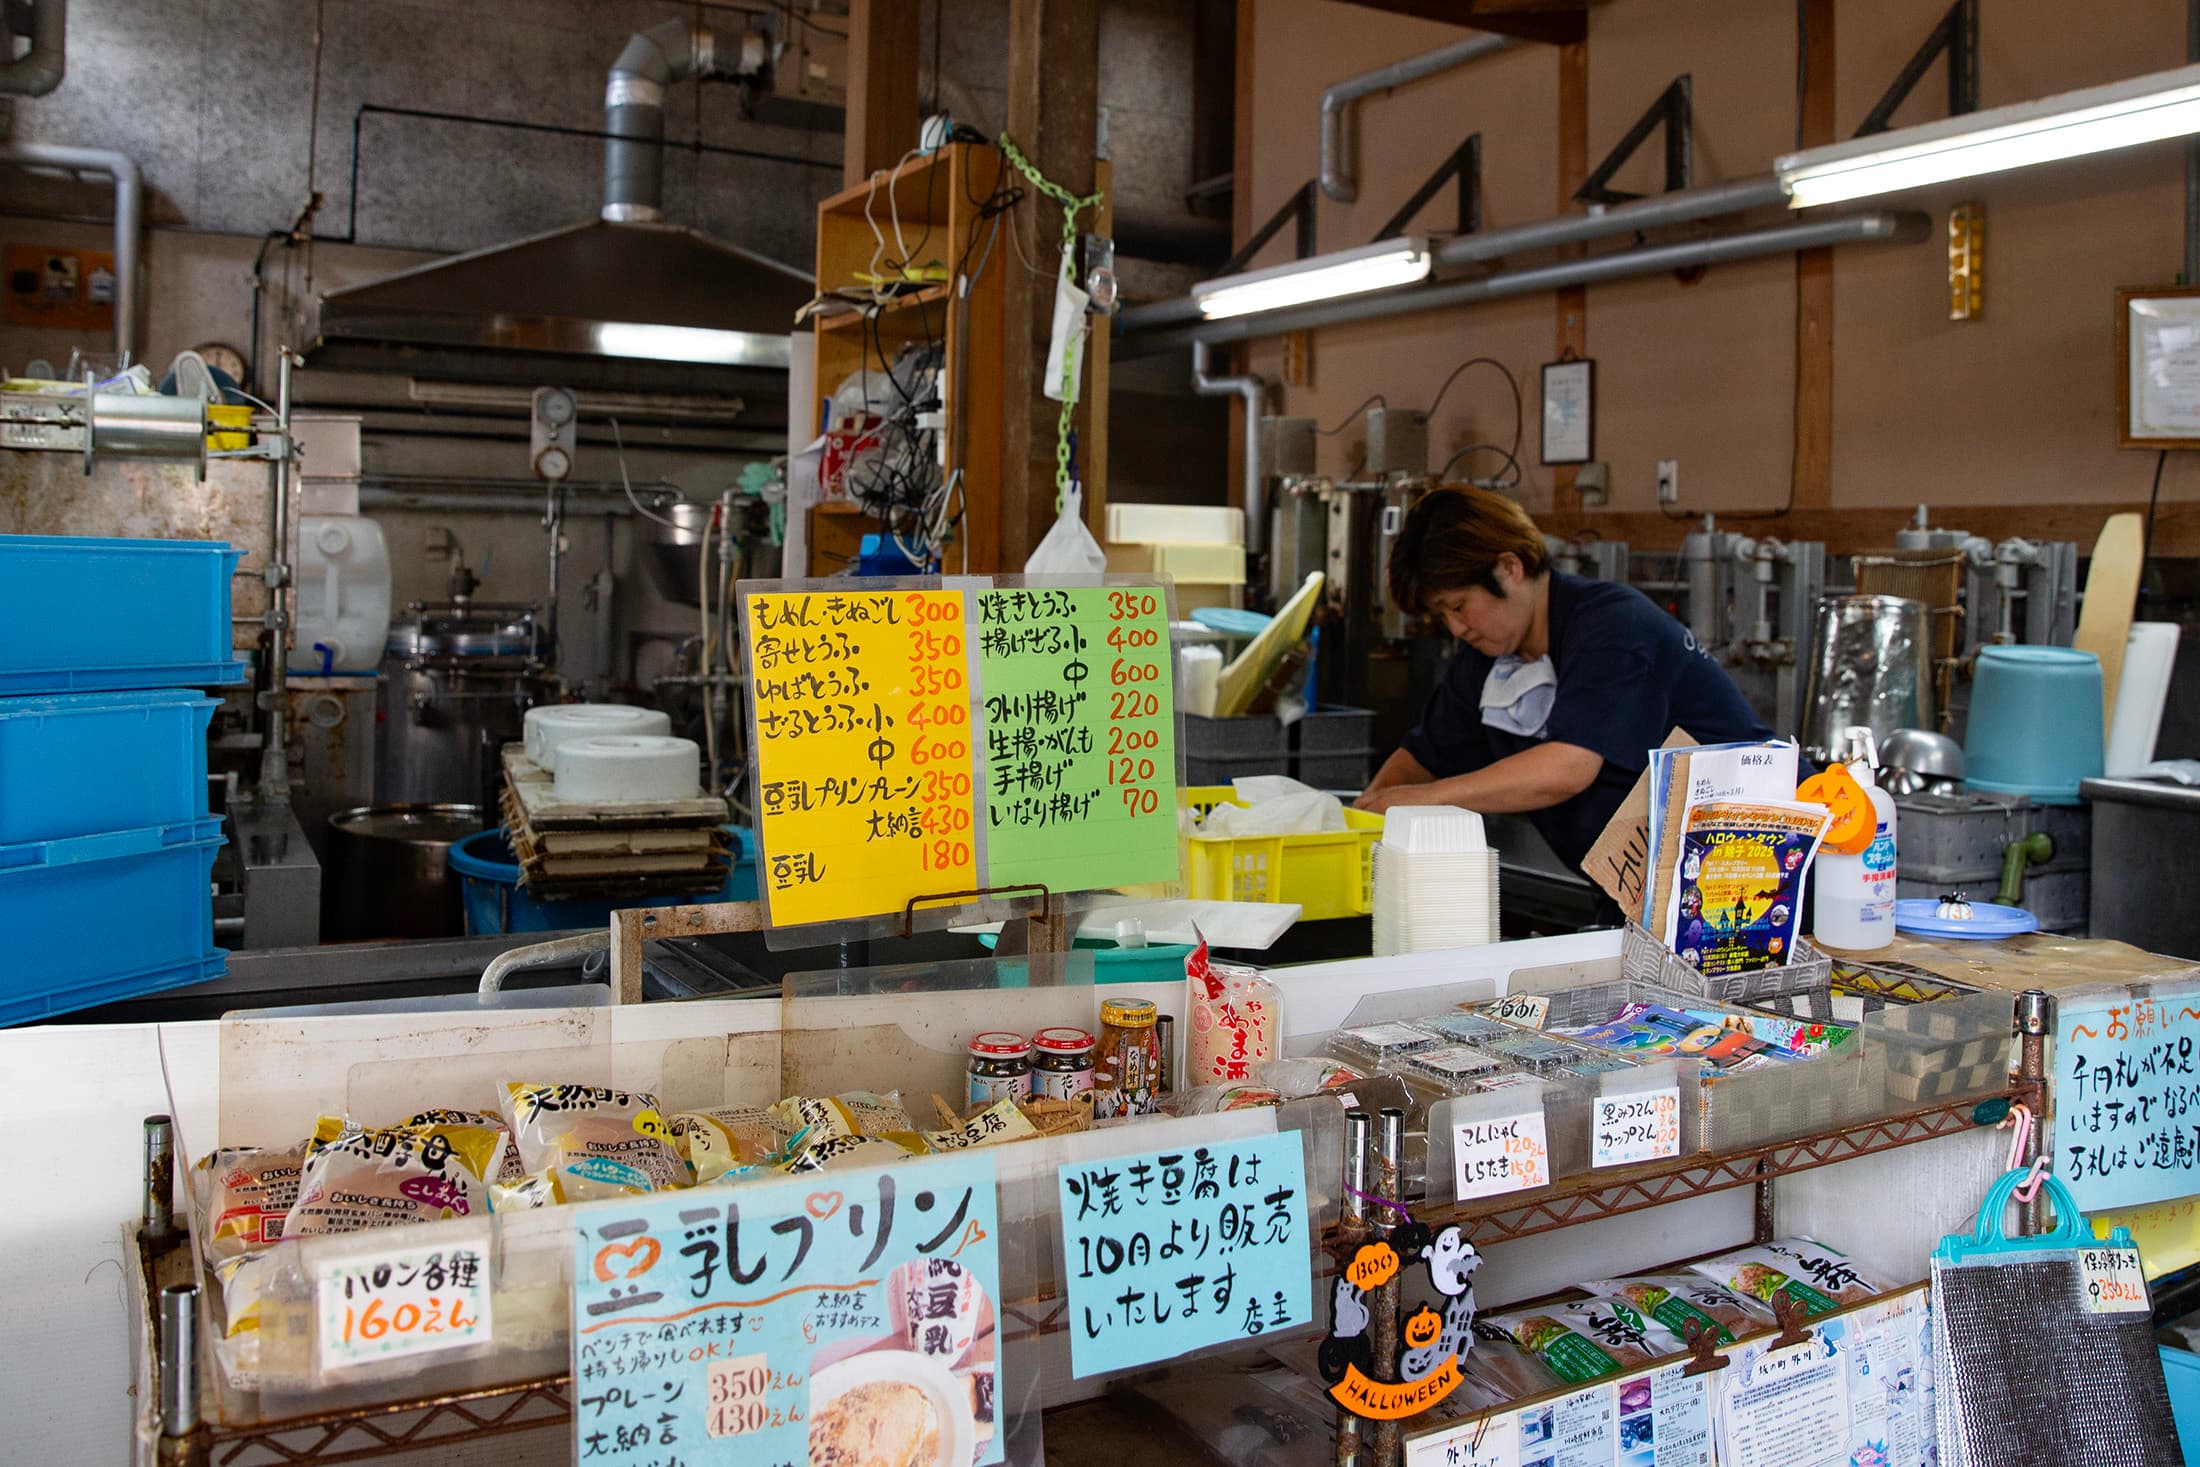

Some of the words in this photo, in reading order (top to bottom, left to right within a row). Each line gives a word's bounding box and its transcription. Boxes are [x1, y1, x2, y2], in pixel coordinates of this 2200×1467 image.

[905, 594, 959, 627] 300
[978, 591, 1077, 624] 焼きとうふ
[1108, 591, 1157, 621] 350
[756, 632, 860, 669] 寄せとうふ
[908, 629, 961, 662] 350
[1107, 626, 1158, 653] 400
[756, 666, 870, 703] ゆばとうふ
[909, 664, 962, 697] 350
[1063, 657, 1089, 690] 中
[1111, 658, 1159, 686] 600
[906, 701, 966, 731] 400
[1110, 690, 1159, 721] 220
[868, 736, 895, 770] 中
[910, 735, 966, 765] 600
[1107, 726, 1159, 756] 200
[993, 758, 1074, 796] 手揚げ
[1108, 757, 1155, 785] 120
[1741, 754, 1773, 766] 価格表
[921, 769, 970, 803] 350
[866, 806, 923, 842] 大納言
[920, 804, 970, 835] 430
[990, 789, 1100, 828] いなり揚げ
[1123, 788, 1159, 818] 70
[1705, 832, 1787, 845] ハロウィンタウン
[1747, 846, 1775, 858] 2025
[771, 851, 826, 890] 豆乳
[922, 839, 970, 871] 180
[1245, 1001, 1266, 1057] おいしい
[1128, 1050, 1138, 1085] なめ茸
[2073, 1036, 2200, 1101] 千円札が不足
[1654, 1096, 1676, 1112] 130
[1462, 1120, 1520, 1147] こんにゃく
[1656, 1127, 1677, 1143] 120
[1066, 1147, 1261, 1221] 焼き豆腐は
[1464, 1155, 1509, 1184] しらたき
[1510, 1159, 1535, 1176] 150
[587, 1174, 971, 1315] 豆乳プリン
[1078, 1185, 1294, 1278] 10月より販売
[1356, 1254, 1392, 1280] BOO
[816, 1291, 867, 1310] 大納言
[1084, 1262, 1237, 1338] いたします
[1241, 1291, 1292, 1334] 店主
[342, 1297, 478, 1345] 160えん
[581, 1312, 745, 1358] ベンチで食べれます
[815, 1312, 880, 1329] おすすめデス
[581, 1379, 685, 1417] プレーン
[1345, 1371, 1451, 1410] HALLOWEEN
[583, 1411, 678, 1458] 大納言
